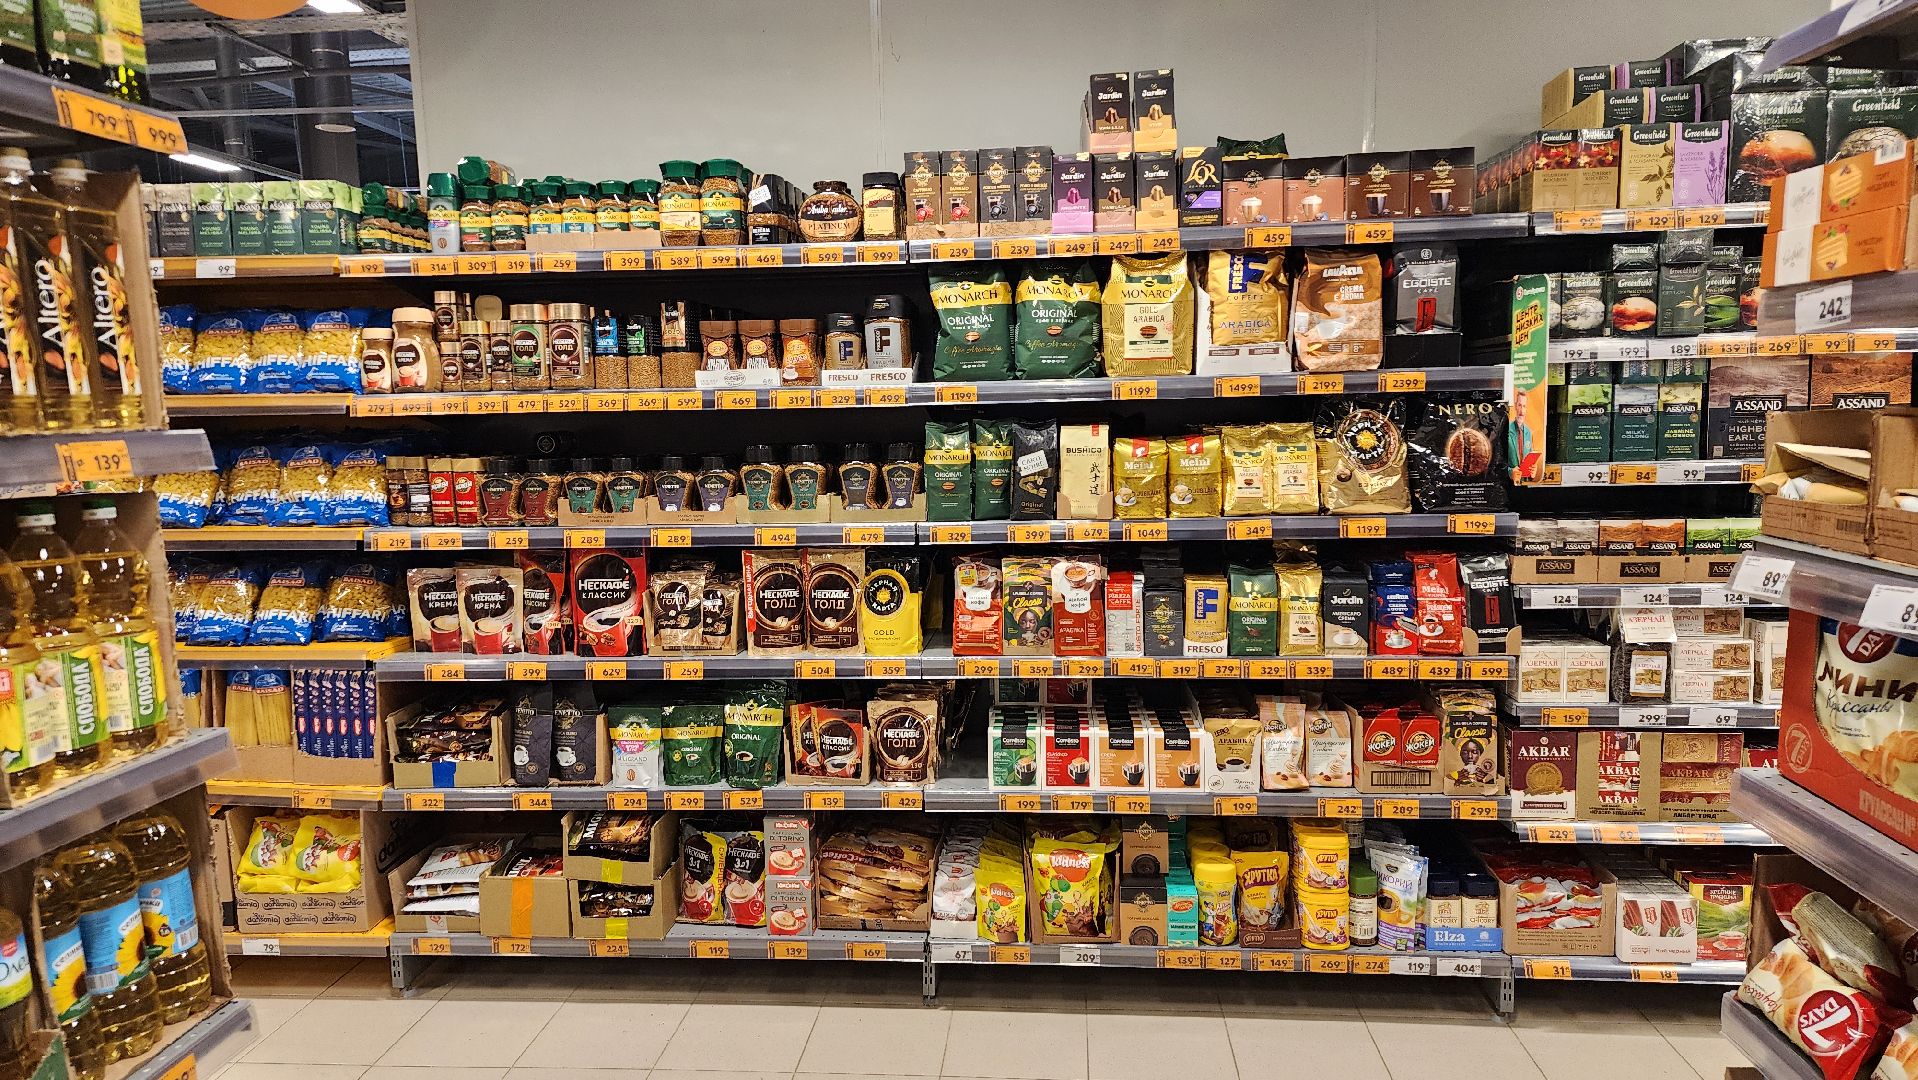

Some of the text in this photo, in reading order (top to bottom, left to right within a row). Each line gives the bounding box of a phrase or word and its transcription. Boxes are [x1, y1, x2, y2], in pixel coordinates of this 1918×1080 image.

[1634, 67, 1661, 76] Greenfield
[1579, 72, 1606, 82] Greenfield
[1098, 91, 1122, 100] Jardin
[1142, 89, 1167, 97] Jardin
[1661, 93, 1690, 102] Greenfield
[1610, 95, 1639, 105] Greenfield
[1853, 97, 1902, 112] Greenfield
[86, 108, 117, 130] 799
[149, 126, 177, 147] 999
[1541, 132, 1572, 142] Greenfield
[1634, 130, 1668, 140] Greenfield
[1685, 128, 1720, 138] Greenfield
[1101, 172, 1126, 180] Jardin
[1144, 170, 1168, 178] Jardin
[702, 200, 735, 208] MONARCH
[1649, 216, 1668, 226] 129
[1700, 214, 1718, 223] 129
[808, 223, 850, 231] PLATINUM
[1263, 233, 1285, 243] 459
[1366, 229, 1387, 239] 459
[1109, 241, 1129, 251] 249
[1153, 238, 1173, 248] 249
[949, 248, 969, 257] 239
[1010, 245, 1030, 255] 239
[1066, 243, 1085, 253] 249
[1403, 277, 1452, 289] EGOISTE
[1618, 279, 1652, 288] Greenfield
[1026, 285, 1084, 298] MONARCH
[1121, 288, 1178, 299] MONARCH
[1340, 286, 1364, 294] CREMA
[939, 289, 998, 305] MONARCH
[34, 258, 66, 349] Altero
[91, 266, 120, 351] Altero
[1031, 308, 1078, 318] ORIGINAL
[1139, 306, 1159, 314] GOLD
[1516, 302, 1538, 319] ЦЕНТР
[1819, 298, 1843, 319] 242
[948, 314, 994, 325] ORIGINAL
[1133, 314, 1166, 323] ARABICA
[1516, 313, 1543, 332] НИЗКИХ
[1219, 320, 1272, 329] ARABICA
[1515, 328, 1530, 346] ЦЕН
[554, 343, 574, 351] ГОЛД
[1769, 343, 1791, 351] 269
[1826, 341, 1841, 349] 99
[1874, 340, 1889, 348] 99
[515, 345, 536, 353] ГОЛД
[1621, 348, 1640, 357] 199
[1670, 345, 1691, 354] 189
[1564, 350, 1583, 358] 199
[828, 374, 859, 382] FRESCO
[870, 372, 907, 381] FRESCO
[1229, 383, 1253, 392] 1499
[1313, 381, 1337, 389] 2199
[1393, 379, 1419, 387] 2399
[1129, 387, 1150, 396] 1199
[518, 401, 536, 410] 479
[638, 398, 658, 407] 369
[1735, 400, 1782, 411] ASSAND
[1837, 399, 1886, 408] ASSAND
[1439, 403, 1493, 416] NERO
[1622, 406, 1652, 414] ASSAND
[1666, 405, 1695, 413] ASSAND
[94, 454, 121, 471] 139
[1124, 461, 1153, 470] Meinl
[1180, 458, 1210, 467] Meinl
[1588, 472, 1603, 481] 99
[1683, 470, 1698, 478] 99
[1465, 521, 1488, 529] 1199
[770, 533, 791, 542] 494
[1025, 531, 1044, 540] 399
[1138, 529, 1161, 538] 1049
[1539, 561, 1572, 570] ASSAND
[1624, 565, 1658, 574] ASSAND
[578, 576, 630, 591] НЕСКАФЕ
[1471, 579, 1509, 589] EGOISTE
[1763, 571, 1780, 588] 89
[869, 580, 898, 593] ЧЕРНАЯ
[1422, 585, 1448, 594] Meinl
[471, 590, 506, 602] НЕСКАФЕ
[582, 591, 626, 599] КЛАССИК
[760, 589, 800, 599] НЕСКАФЕ
[812, 589, 850, 599] НЕСКАФЕ
[1643, 594, 1662, 603] 124
[1724, 594, 1743, 602] 124
[764, 599, 796, 609] ГОЛД
[815, 599, 845, 609] ГОЛД
[1013, 597, 1043, 608] Classic
[1331, 595, 1364, 605] Jardin
[1553, 596, 1572, 604] 124
[872, 601, 896, 612] КАРТА
[1628, 615, 1665, 624] АЗЕРЧАЙ
[1187, 645, 1224, 654] FRESCO
[1524, 660, 1559, 668] АЗЕРЧАЙ
[1570, 660, 1604, 668] АЗЕРЧАЙ
[811, 666, 830, 675] 504
[1430, 666, 1450, 675] 439
[133, 646, 153, 716] СЛОБОДА
[72, 661, 96, 735] СЛОБОДА
[728, 712, 773, 723] MONARCH
[1563, 715, 1581, 723] 159
[1639, 715, 1660, 723] 299
[1715, 715, 1731, 724] 69
[731, 733, 761, 741] ORIGINAL
[884, 729, 921, 739] НЕСКАФЕ
[1455, 727, 1486, 738] Classic
[888, 738, 916, 748] ГОЛД
[1367, 738, 1395, 751] ЖОКЕЙ
[1405, 738, 1435, 751] ЖОКЕЙ
[1518, 746, 1570, 757] AKBAR
[1599, 765, 1640, 776] AKBAR
[1669, 769, 1710, 778] AKBAR
[680, 797, 699, 806] 299
[740, 797, 758, 806] 529
[899, 797, 917, 807] 429
[1337, 805, 1357, 814] 242
[1470, 806, 1491, 816] 299
[1549, 830, 1568, 839] 229
[1316, 853, 1338, 863] ХРУТКА
[1244, 867, 1278, 885] ХРУТКА
[1316, 910, 1338, 920] ХРУТКА
[1434, 930, 1465, 943] Elza
[263, 944, 274, 952] 79
[955, 950, 968, 958] 67
[1013, 952, 1025, 960] 55
[1077, 953, 1095, 962] 209
[1177, 956, 1194, 964] 139
[1321, 960, 1340, 969] 269
[1366, 961, 1384, 970] 274
[1454, 964, 1474, 973] 404
[1800, 997, 1851, 1049] 7 DAYS
